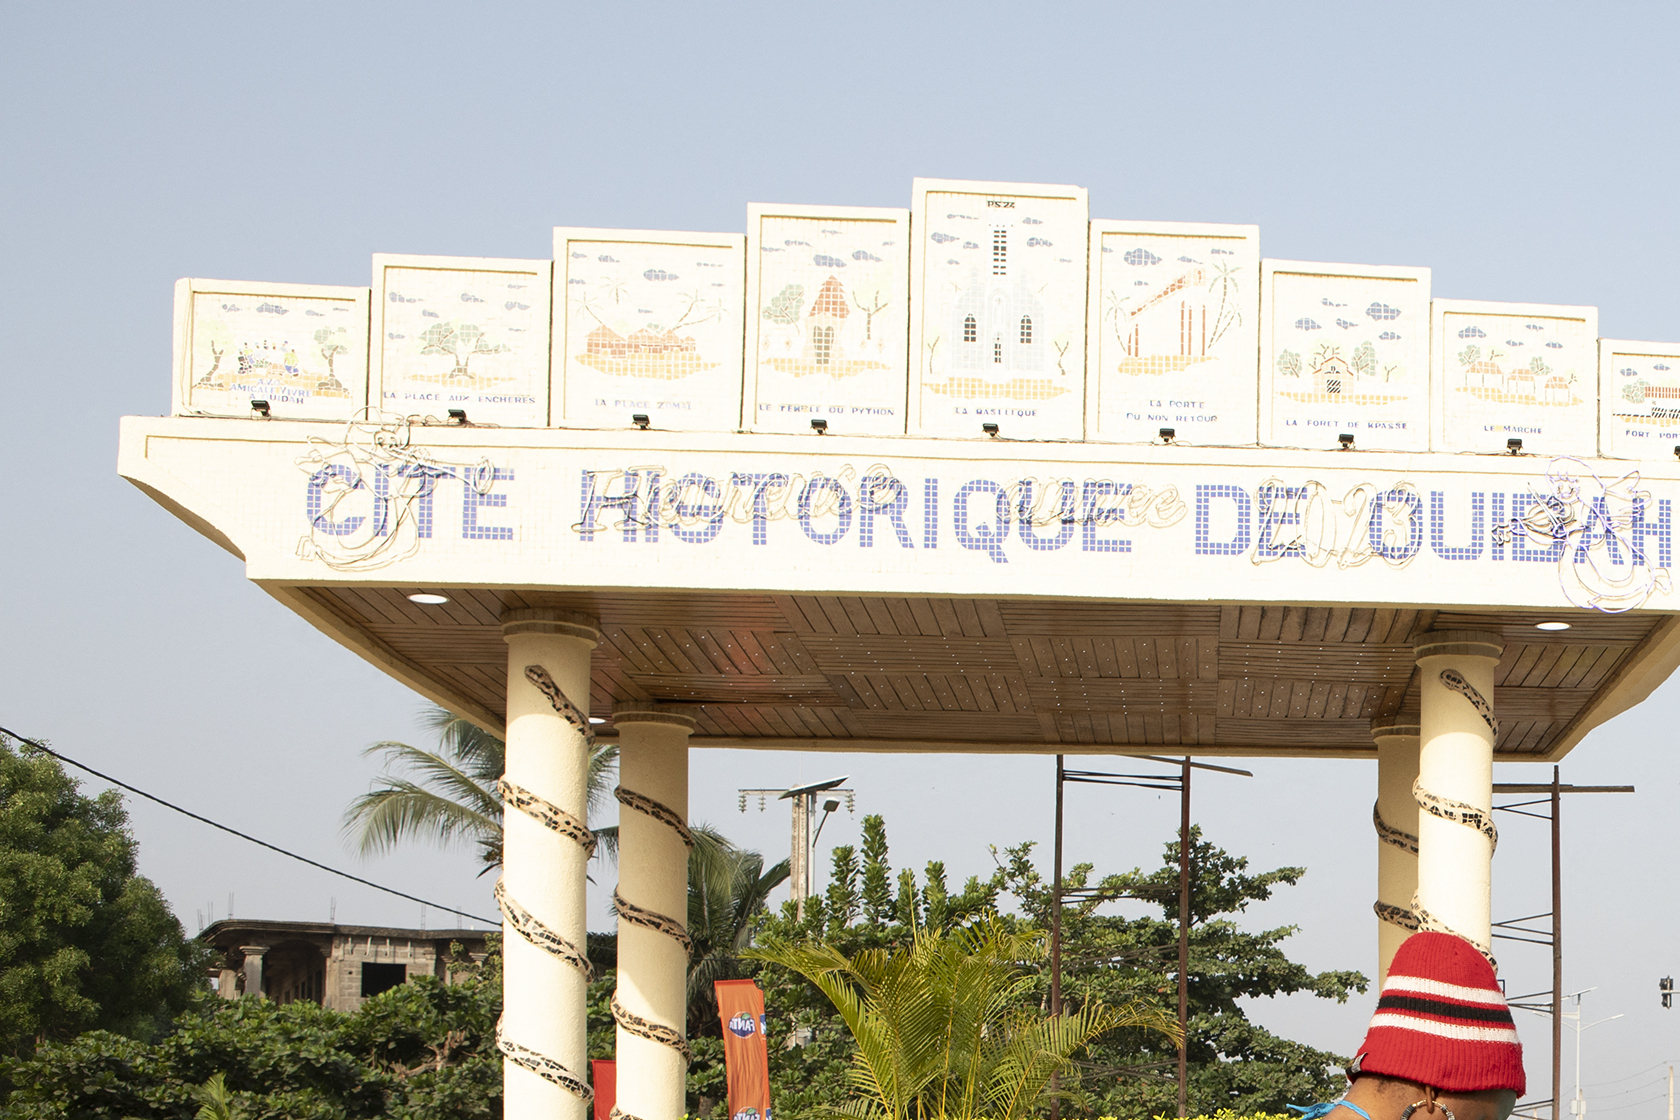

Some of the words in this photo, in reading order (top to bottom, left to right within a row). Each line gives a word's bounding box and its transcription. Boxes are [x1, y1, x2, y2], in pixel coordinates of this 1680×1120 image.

[229, 383, 277, 394] AMICALE
[280, 386, 312, 397] VIVRE
[262, 394, 304, 404] OUIDAH
[404, 392, 440, 401] PLACE
[448, 394, 470, 402] AUX
[478, 396, 536, 404] ENCHERES
[595, 398, 606, 406] LA
[614, 400, 650, 408] PLACE
[1169, 400, 1205, 408] PORTE
[852, 408, 894, 416] PYTHON
[1126, 412, 1140, 420] DU
[1148, 414, 1168, 422] NON
[1307, 420, 1338, 428] FORET
[1367, 422, 1407, 430] KPASSE
[1503, 426, 1542, 434] MARCHE
[1626, 430, 1650, 438] FORT
[307, 464, 515, 541] CITE
[580, 469, 1132, 563] HISTORIQUE
[1195, 484, 1308, 557] DE
[1369, 490, 1672, 568] OUIDAH
